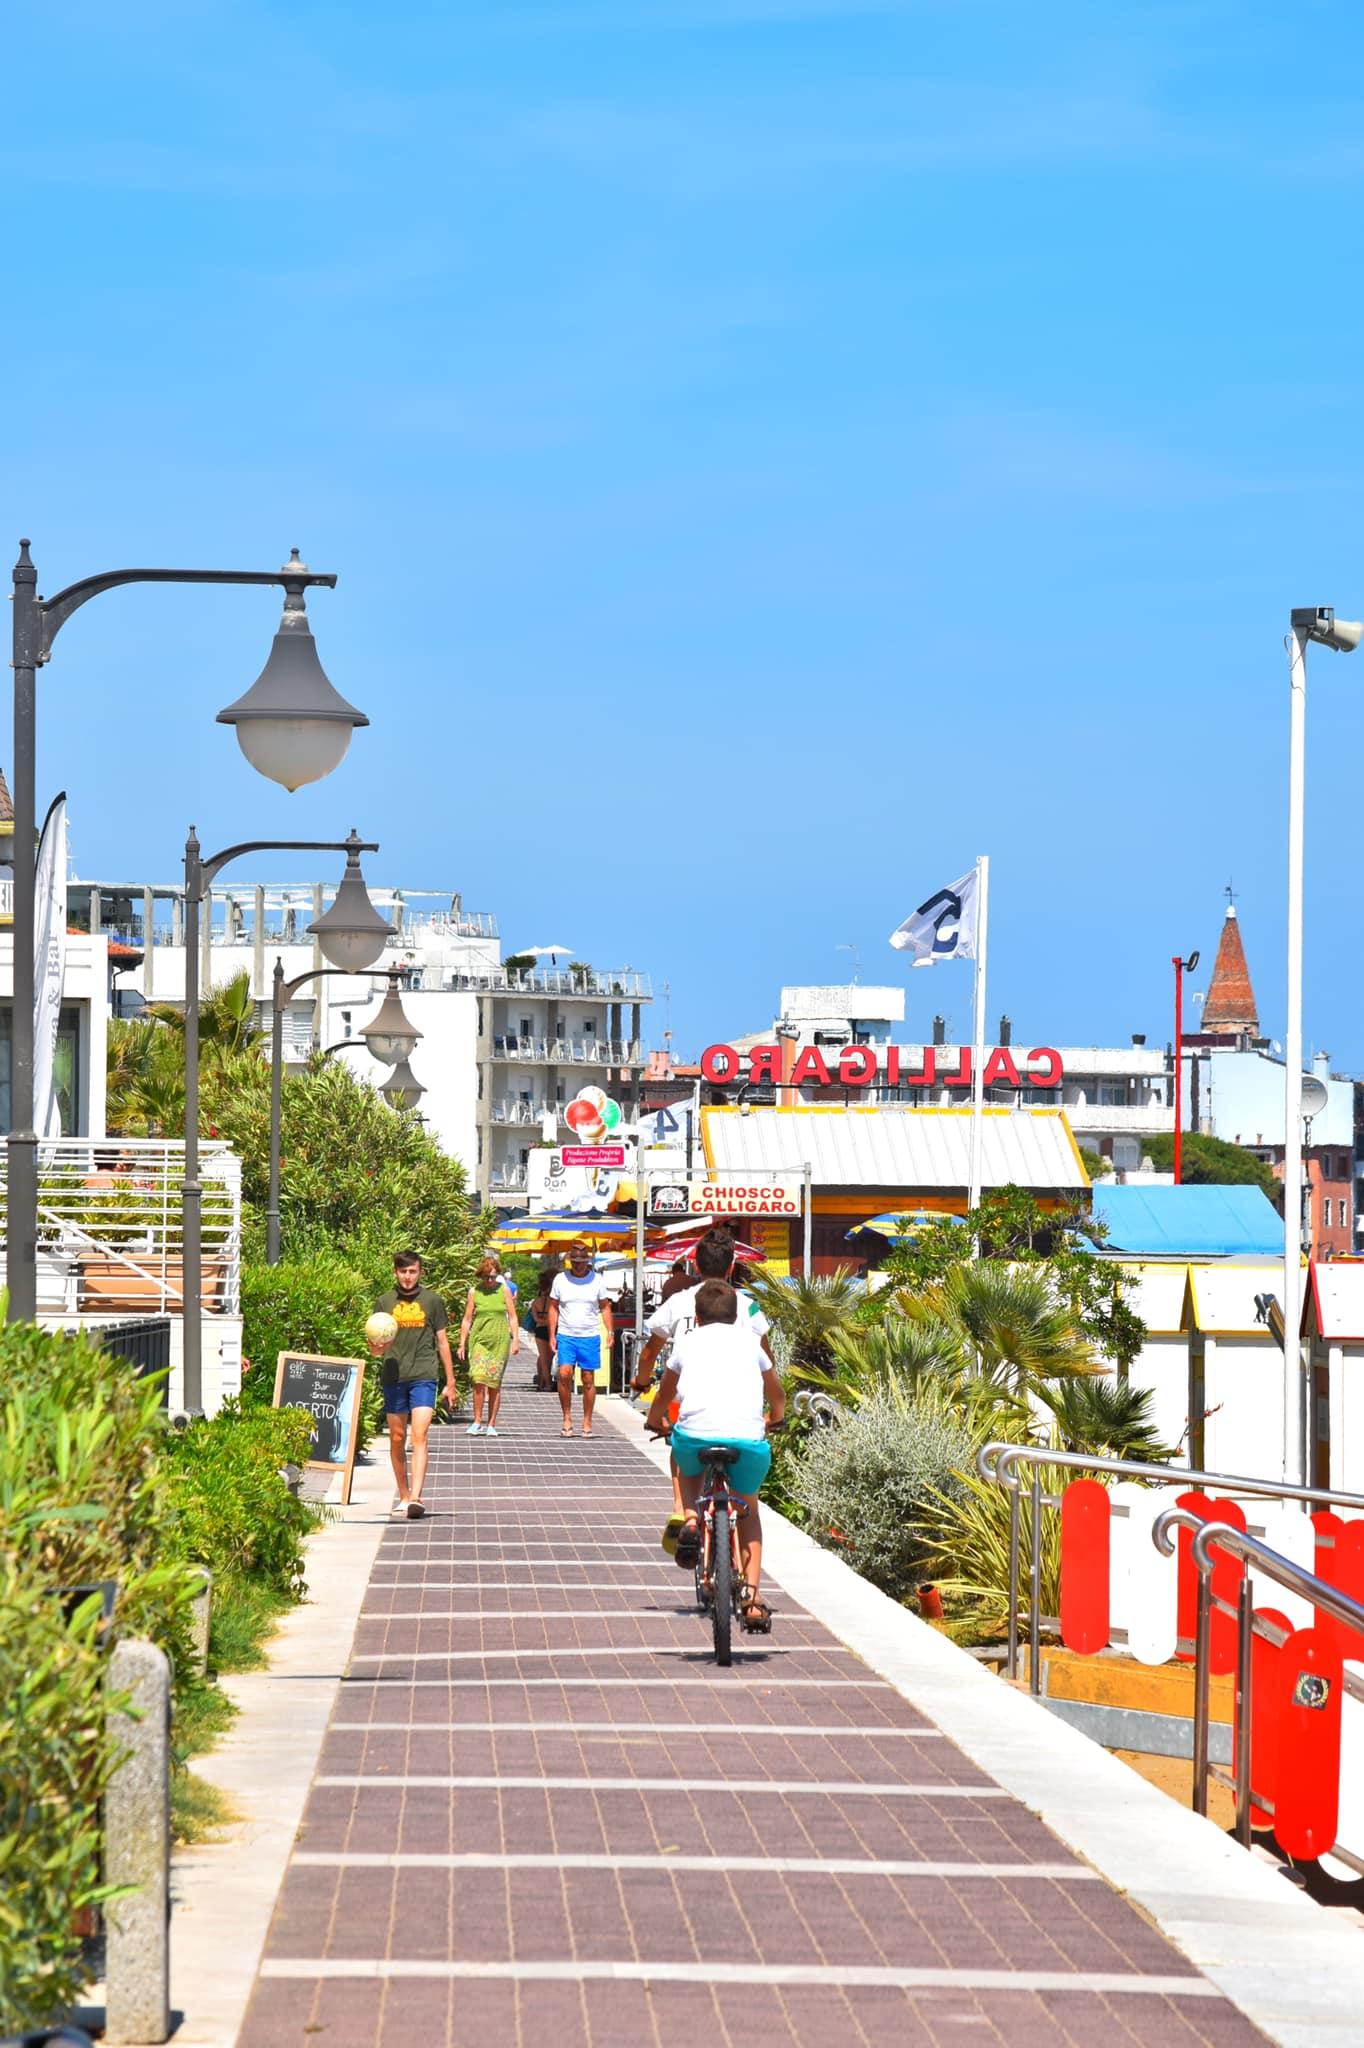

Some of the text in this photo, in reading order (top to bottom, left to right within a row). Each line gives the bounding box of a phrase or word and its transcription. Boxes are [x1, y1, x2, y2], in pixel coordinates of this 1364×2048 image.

[47, 930, 60, 977] Bar
[702, 1187, 785, 1199] CHIOSCO
[691, 1200, 796, 1213] CALLIGARO
[314, 1381, 331, 1391] Bar
